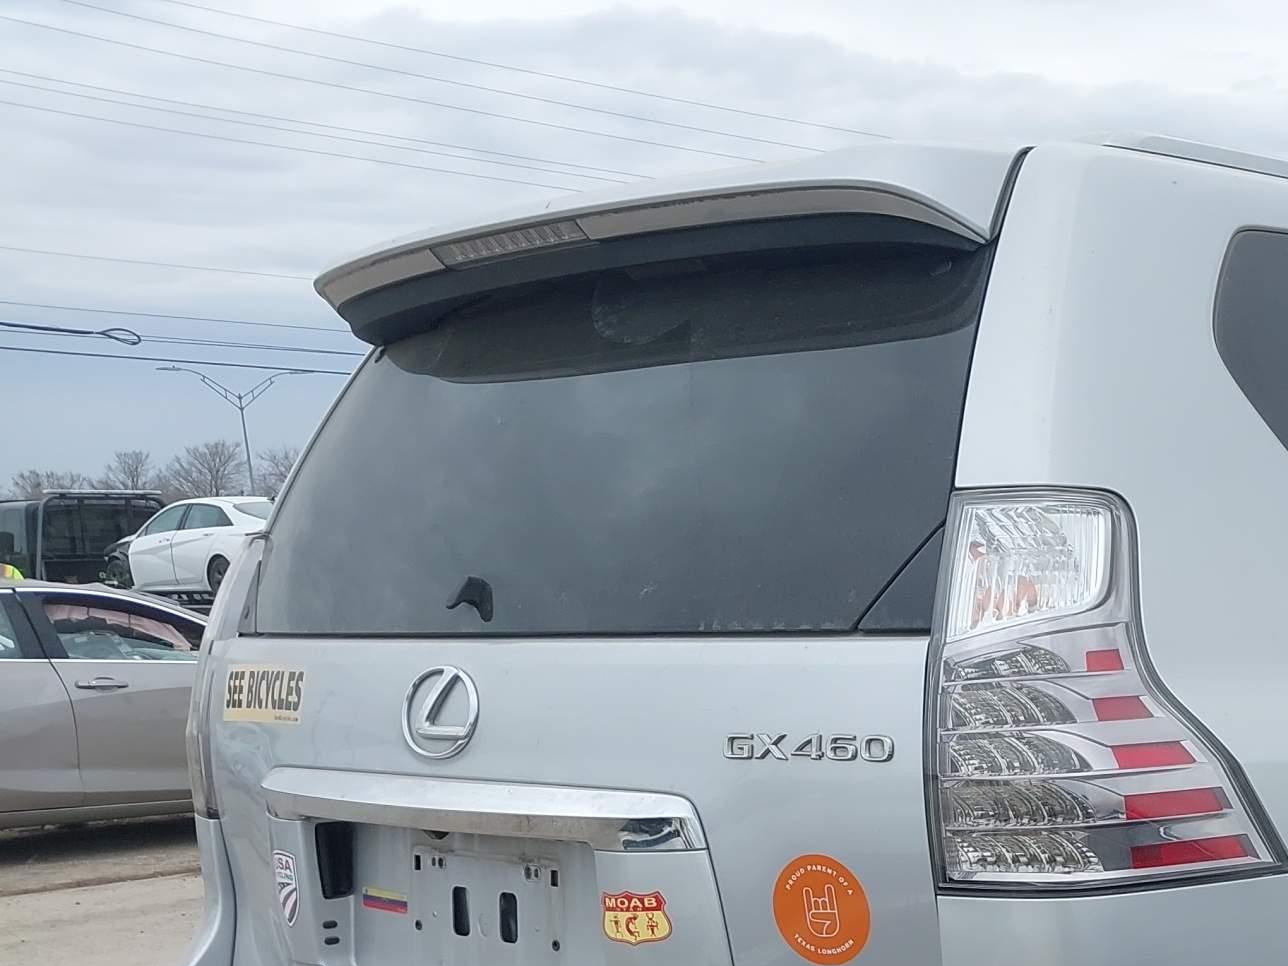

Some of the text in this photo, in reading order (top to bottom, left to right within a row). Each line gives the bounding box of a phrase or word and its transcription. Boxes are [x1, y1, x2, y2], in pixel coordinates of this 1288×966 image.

[226, 670, 304, 712] SEE BICYCLES
[275, 856, 292, 873] SA
[785, 867, 805, 890] PROUD
[807, 865, 837, 877] PARENT
[838, 876, 849, 887] OF
[605, 897, 657, 908] MOAB
[794, 933, 855, 955] TEXAS LONGHORN
